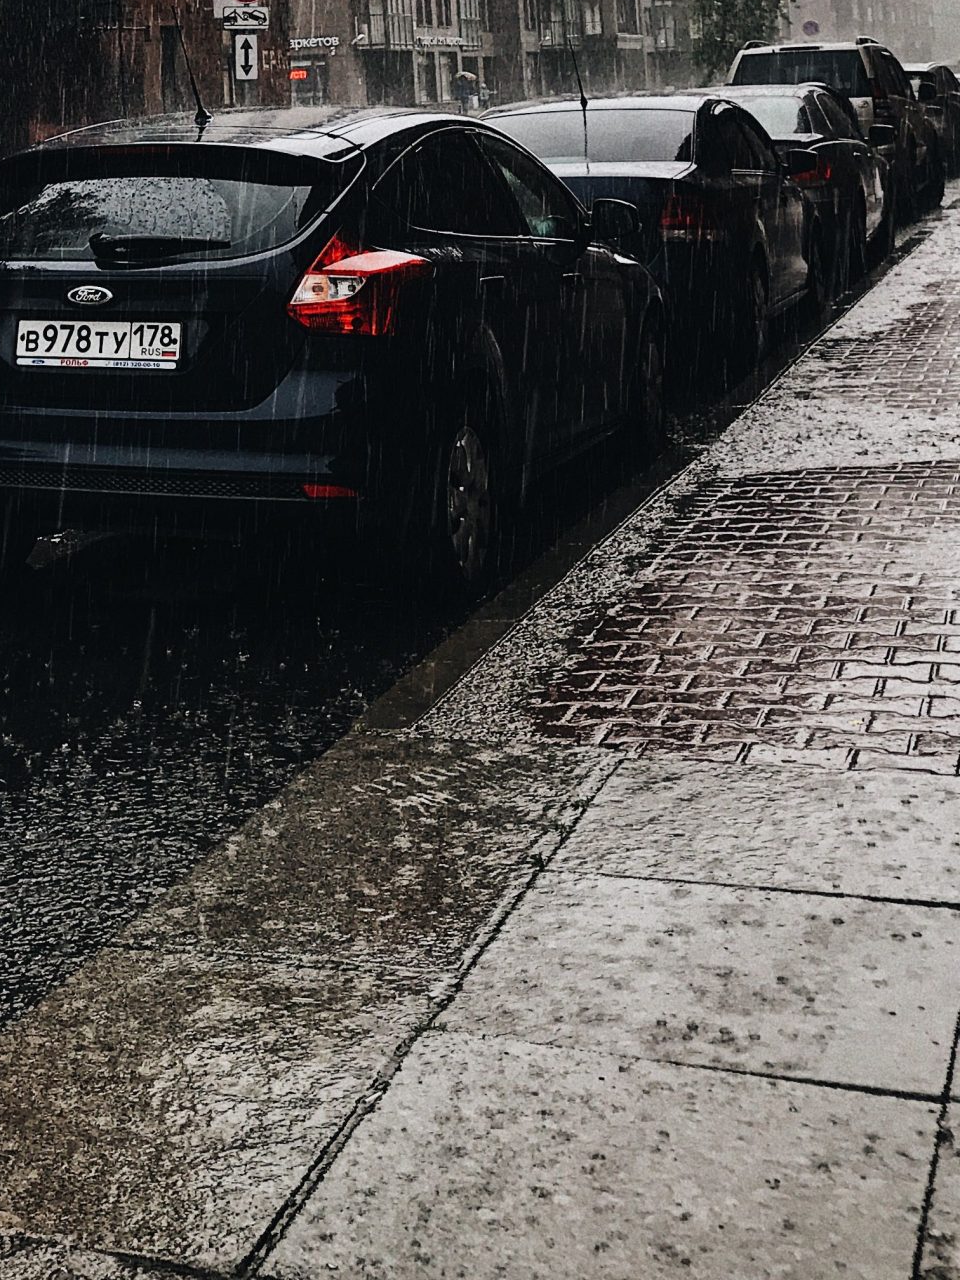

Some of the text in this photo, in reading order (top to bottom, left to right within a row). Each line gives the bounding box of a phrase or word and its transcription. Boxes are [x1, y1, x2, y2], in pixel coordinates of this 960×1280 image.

[75, 288, 102, 302] Ford
[25, 324, 173, 354] В978ТУ 178
[141, 347, 161, 356] RUS
